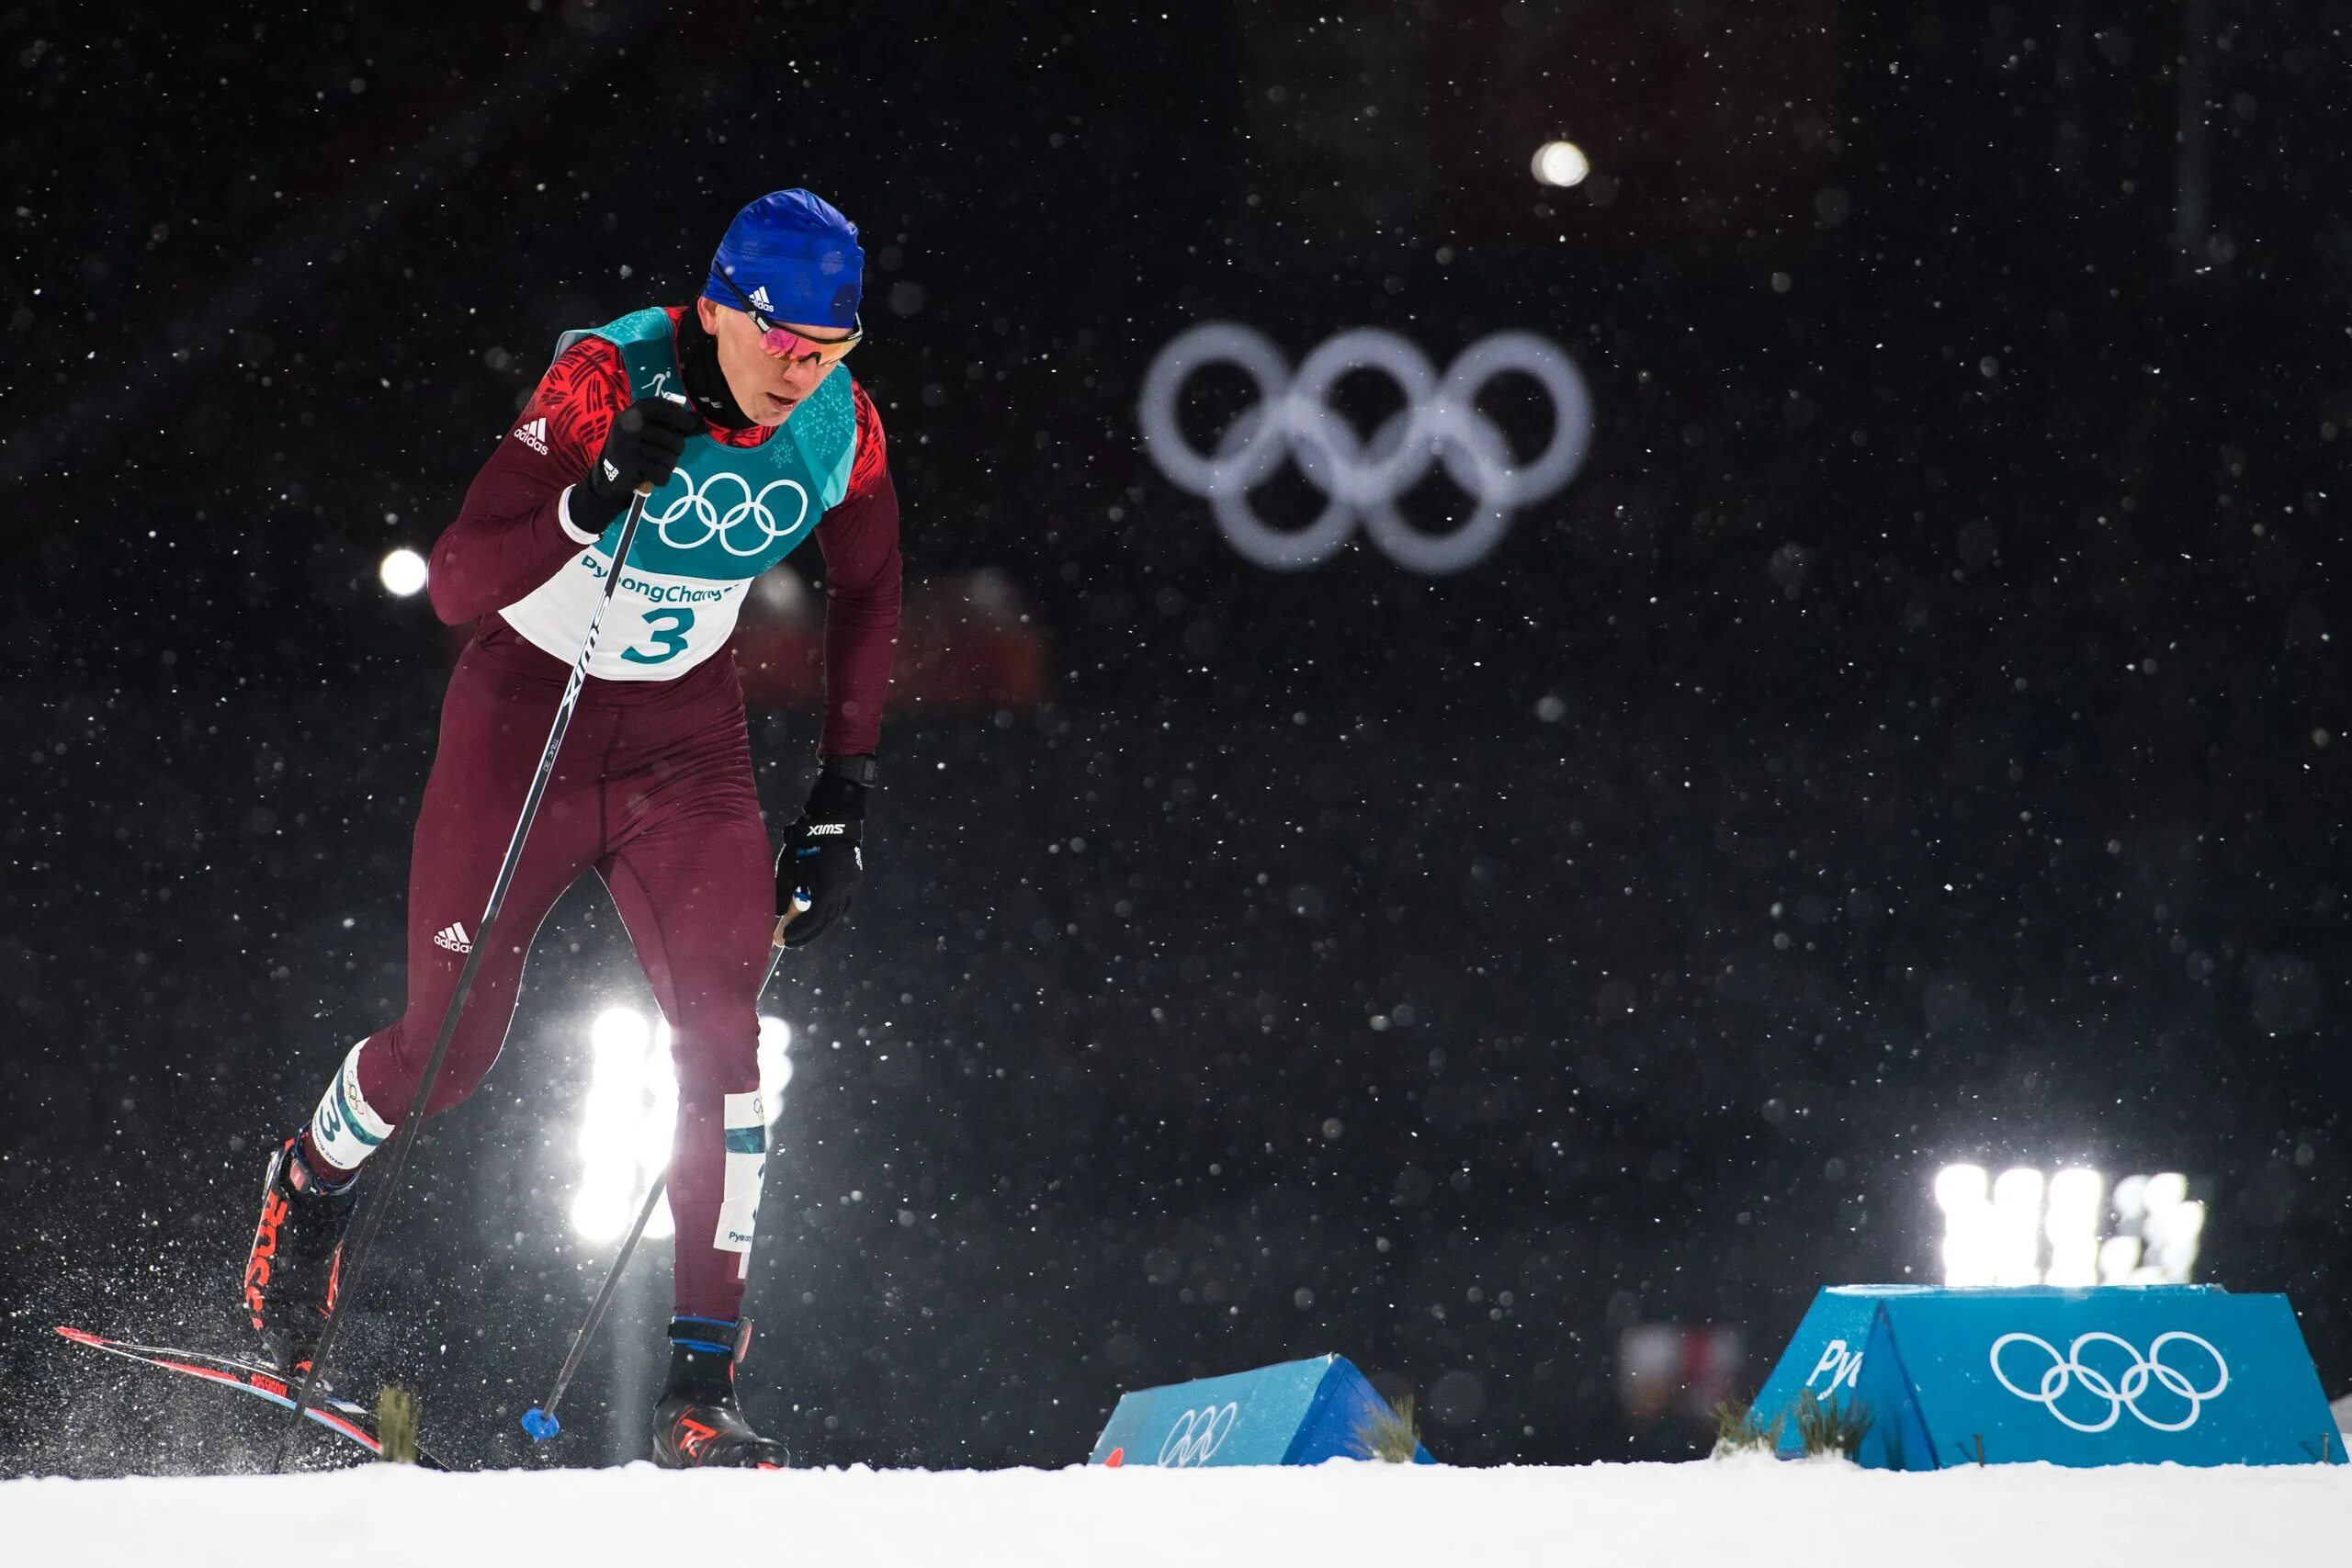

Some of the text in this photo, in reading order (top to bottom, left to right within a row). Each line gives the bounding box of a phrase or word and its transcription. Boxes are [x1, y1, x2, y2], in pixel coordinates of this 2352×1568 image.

[514, 429, 548, 456] adidas
[620, 607, 695, 664] 3
[807, 824, 845, 837] SWIX
[434, 935, 473, 953] adida
[319, 1094, 341, 1142] 3
